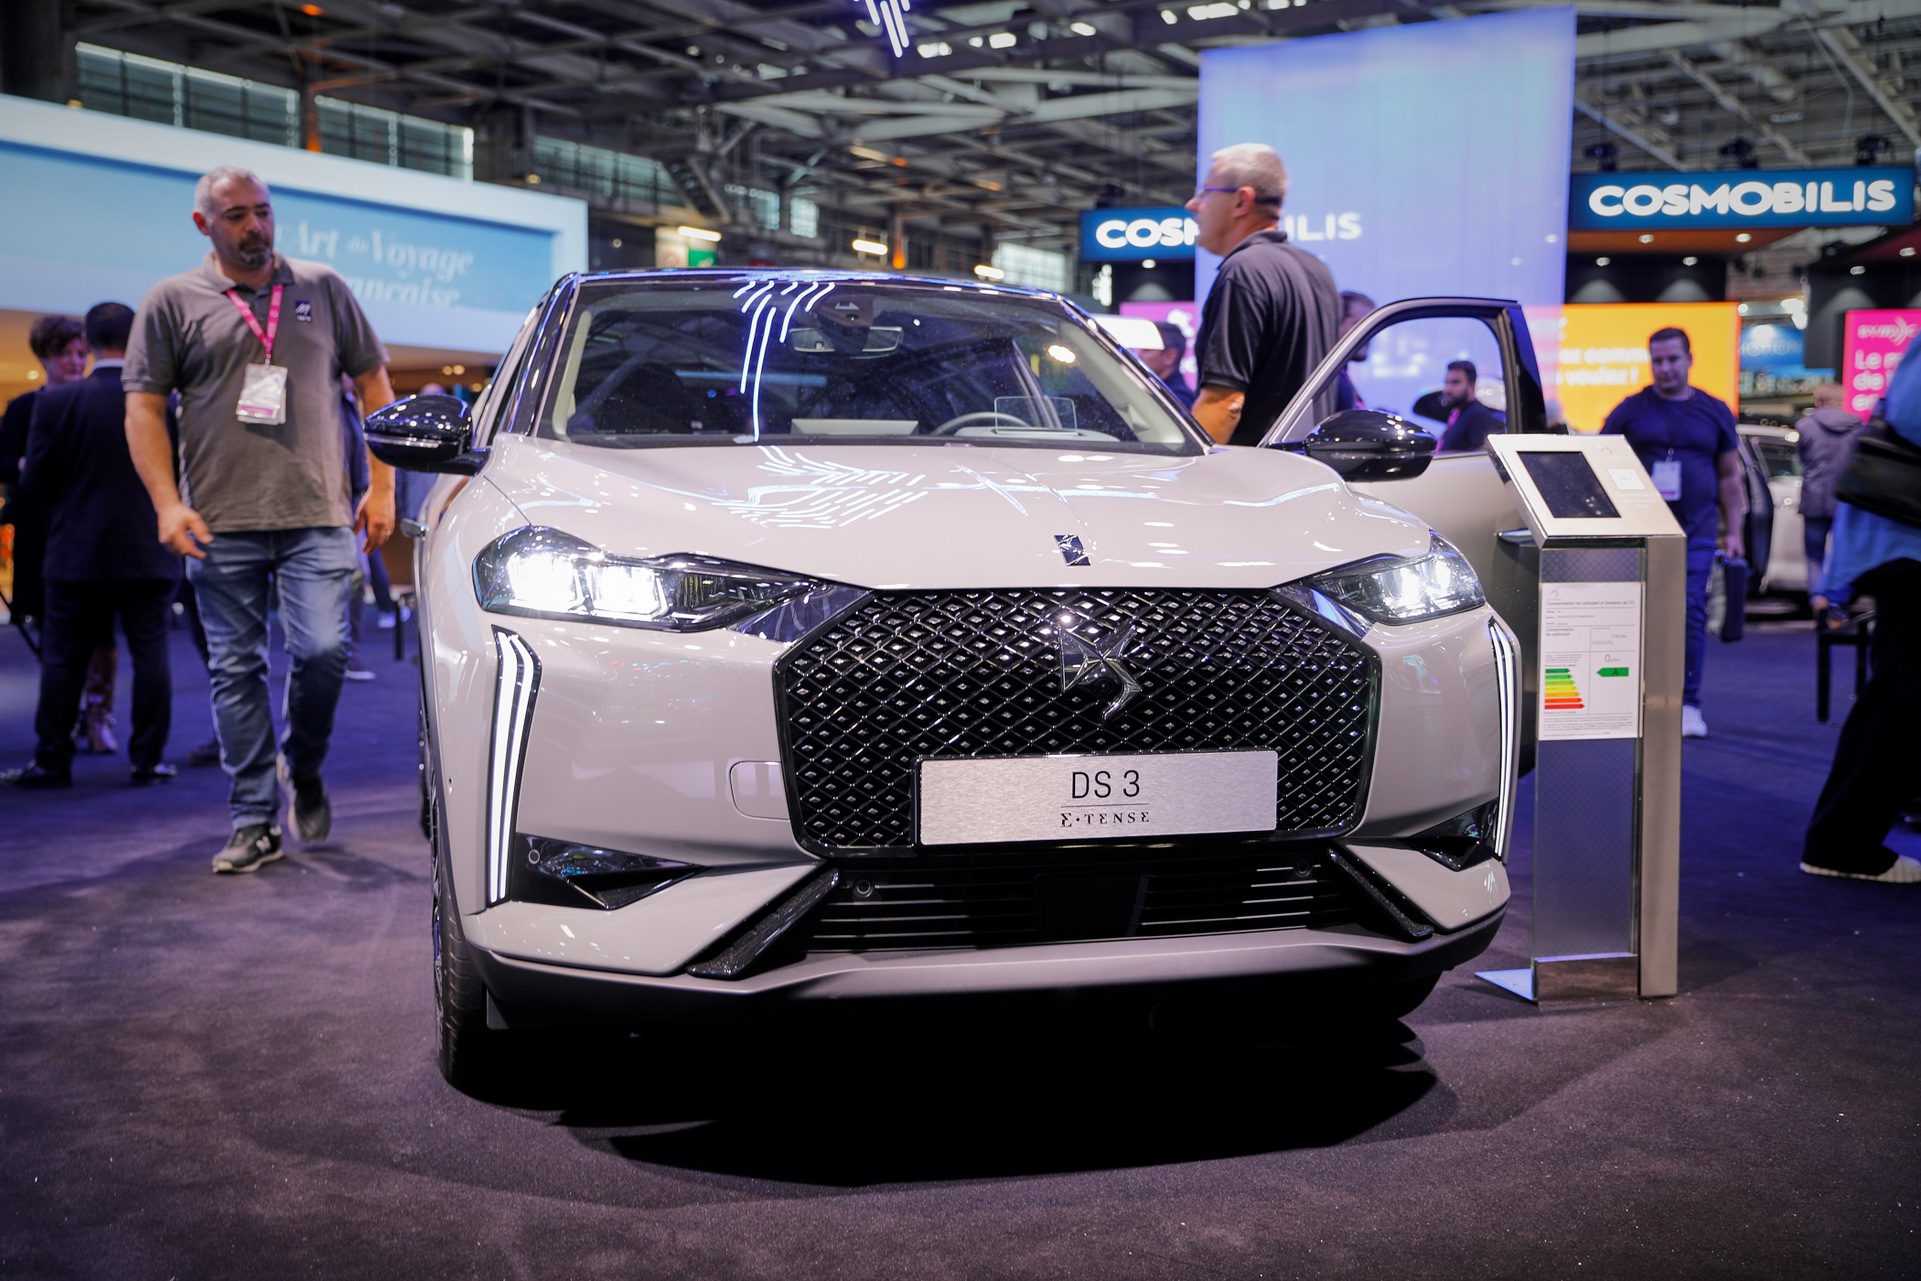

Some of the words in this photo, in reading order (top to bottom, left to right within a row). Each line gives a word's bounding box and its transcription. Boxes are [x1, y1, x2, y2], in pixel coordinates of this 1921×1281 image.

[1589, 180, 1896, 217] COSMOBILIS
[371, 227, 474, 283] Voyage
[1072, 770, 1112, 799] DS
[1123, 769, 1140, 798] 3
